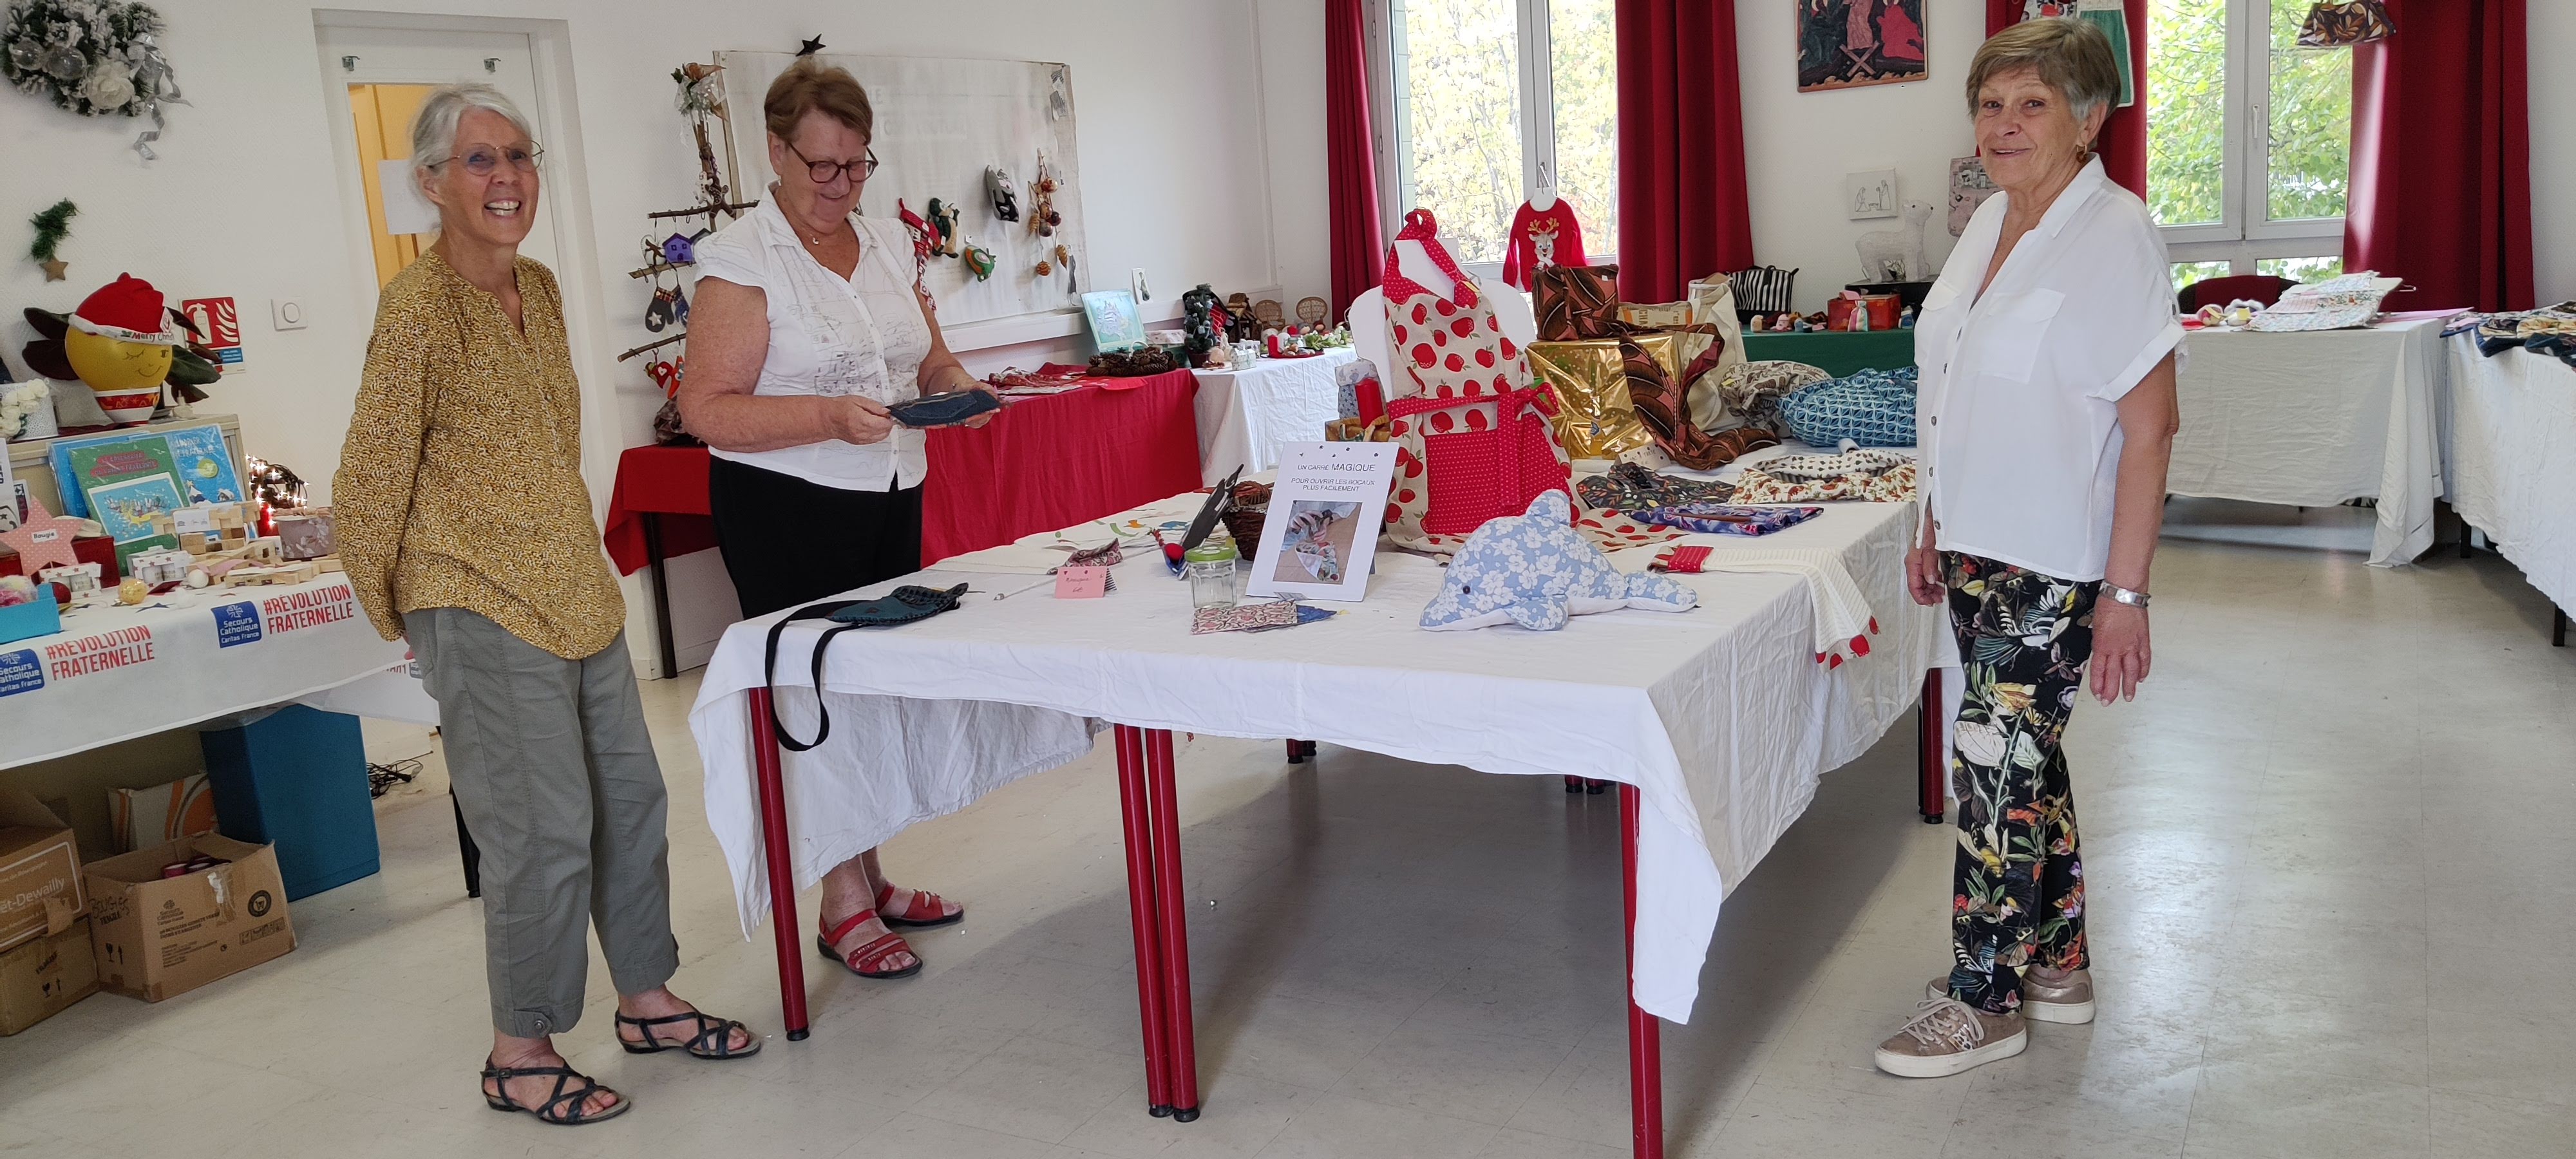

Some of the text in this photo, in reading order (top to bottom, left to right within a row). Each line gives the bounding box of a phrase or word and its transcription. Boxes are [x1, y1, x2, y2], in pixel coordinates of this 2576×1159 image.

[131, 332, 156, 343] Merry
[1331, 464, 1376, 472] MAGIQUE
[263, 583, 352, 616] #RÉVOLUTION
[223, 616, 253, 628] Secours
[267, 601, 354, 634] FRATERNELLE
[220, 623, 259, 636] Catholique
[221, 636, 240, 644] Caritas
[50, 642, 155, 681] FRATERNELLE
[0, 669, 40, 684] atholique
[0, 679, 42, 693] aritas France
